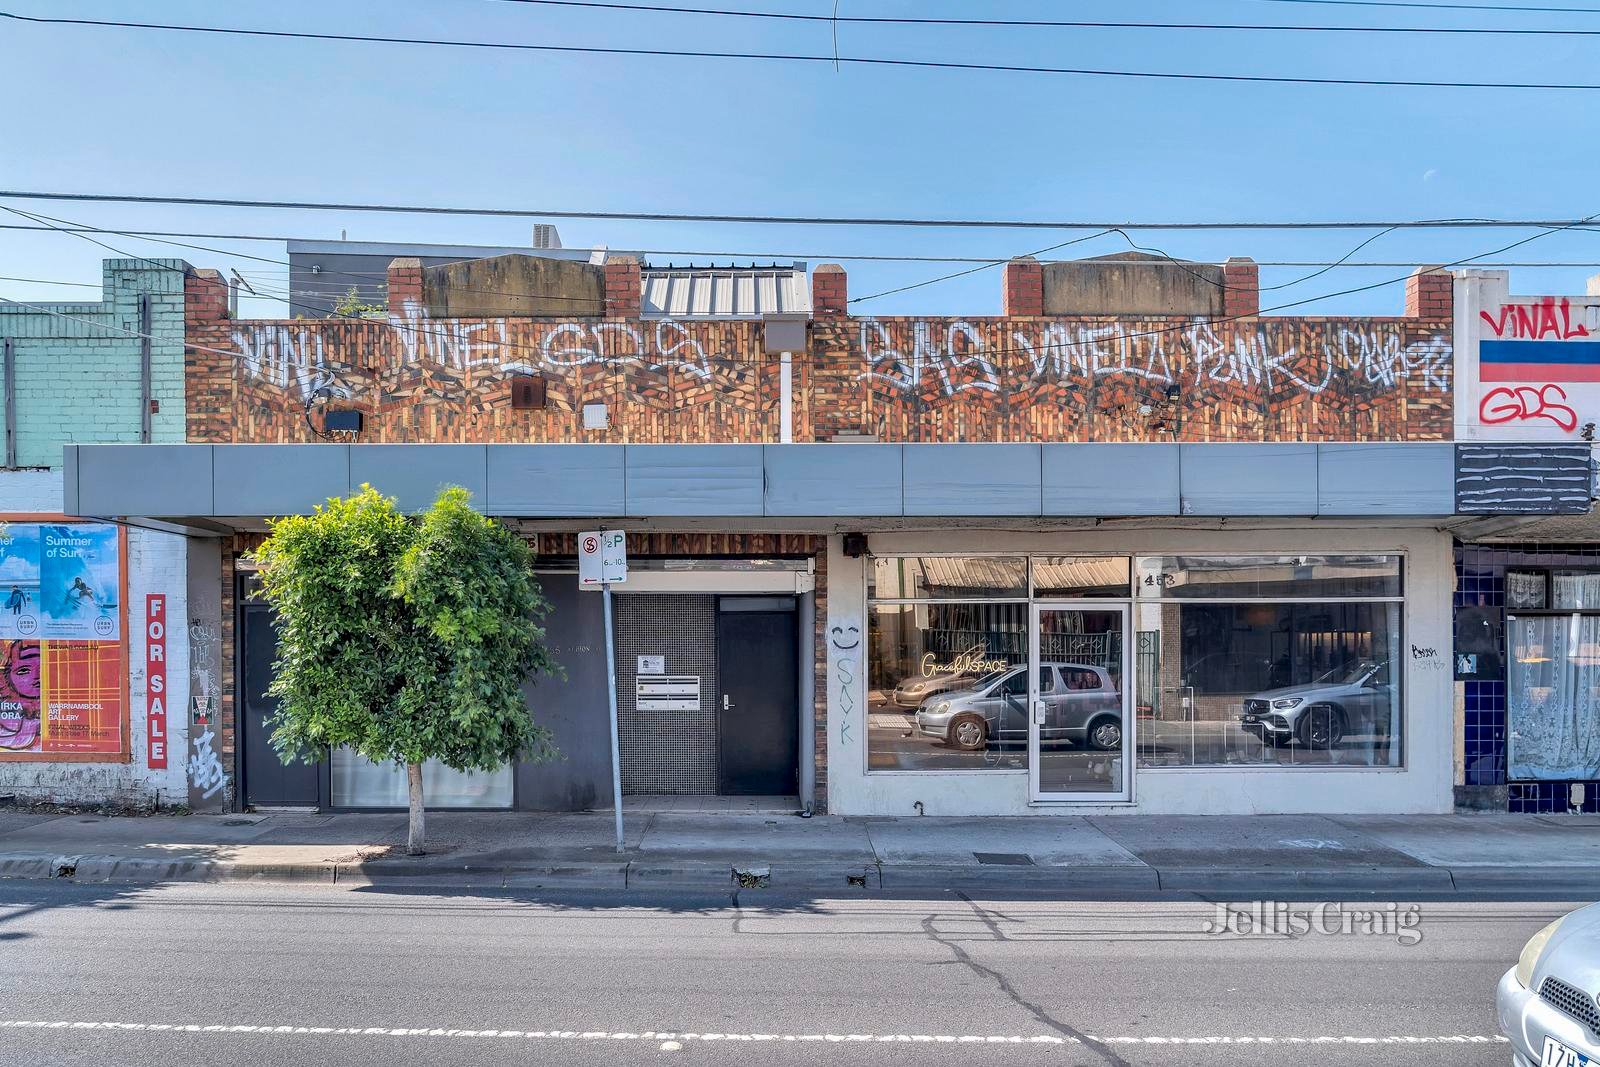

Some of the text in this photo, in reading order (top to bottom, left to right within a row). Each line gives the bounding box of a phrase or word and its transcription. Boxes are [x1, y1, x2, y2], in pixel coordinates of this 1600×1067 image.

[1480, 384, 1577, 433] GDS
[46, 535, 93, 546] Summer
[46, 548, 58, 558] of
[1144, 573, 1175, 586] 453
[150, 599, 164, 760] FOR SALE
